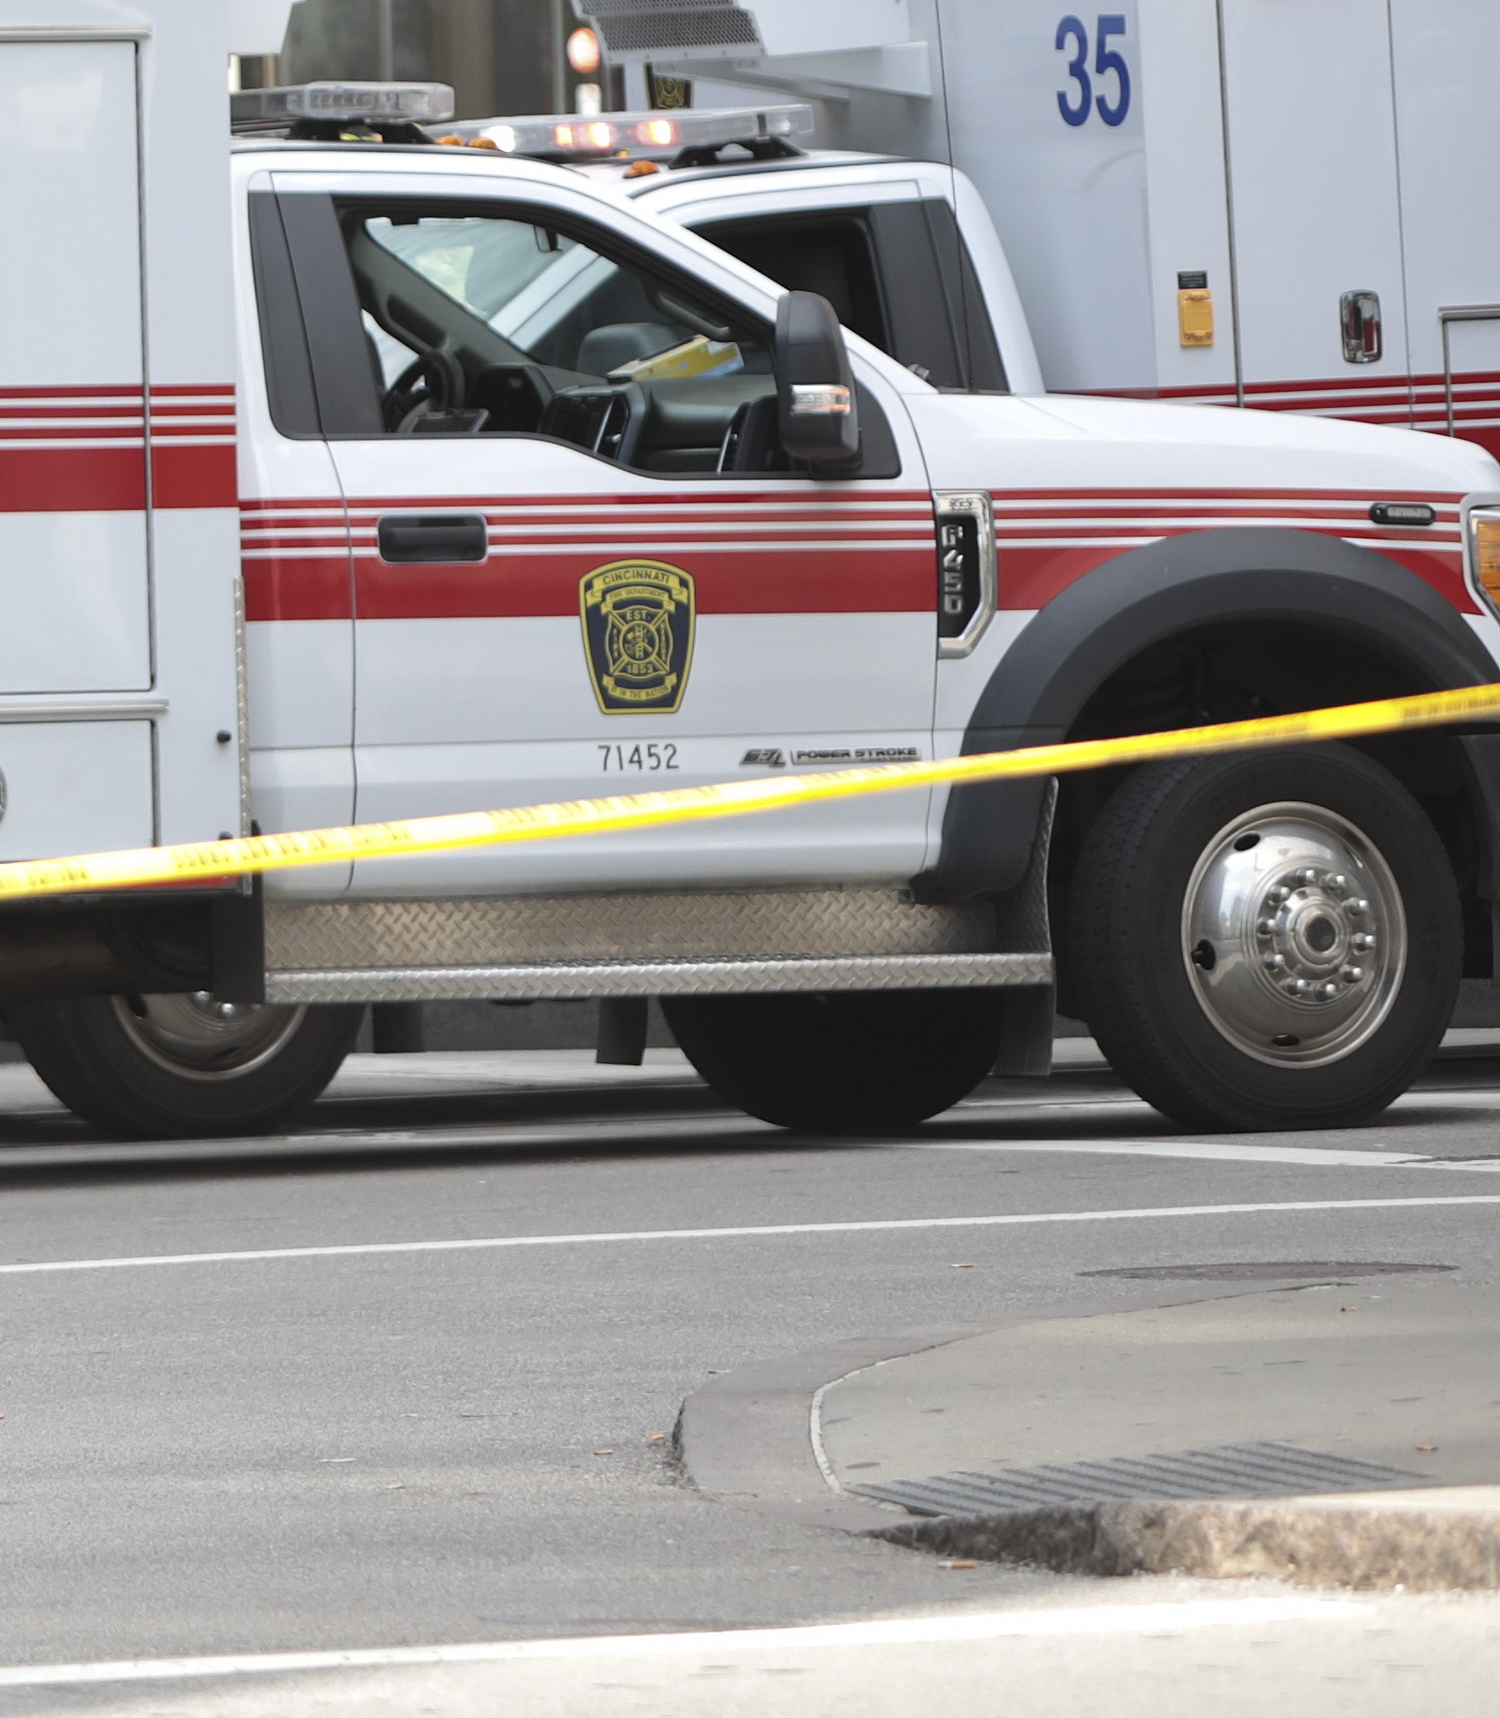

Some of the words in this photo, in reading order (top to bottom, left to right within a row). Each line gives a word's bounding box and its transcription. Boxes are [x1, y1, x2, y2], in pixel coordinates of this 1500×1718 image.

[1055, 13, 1131, 127] 35
[601, 568, 671, 586] CINCINNATI
[626, 663, 654, 674] 1853
[597, 742, 680, 771] 71452
[797, 749, 851, 760] POWER
[854, 746, 918, 757] STROKE
